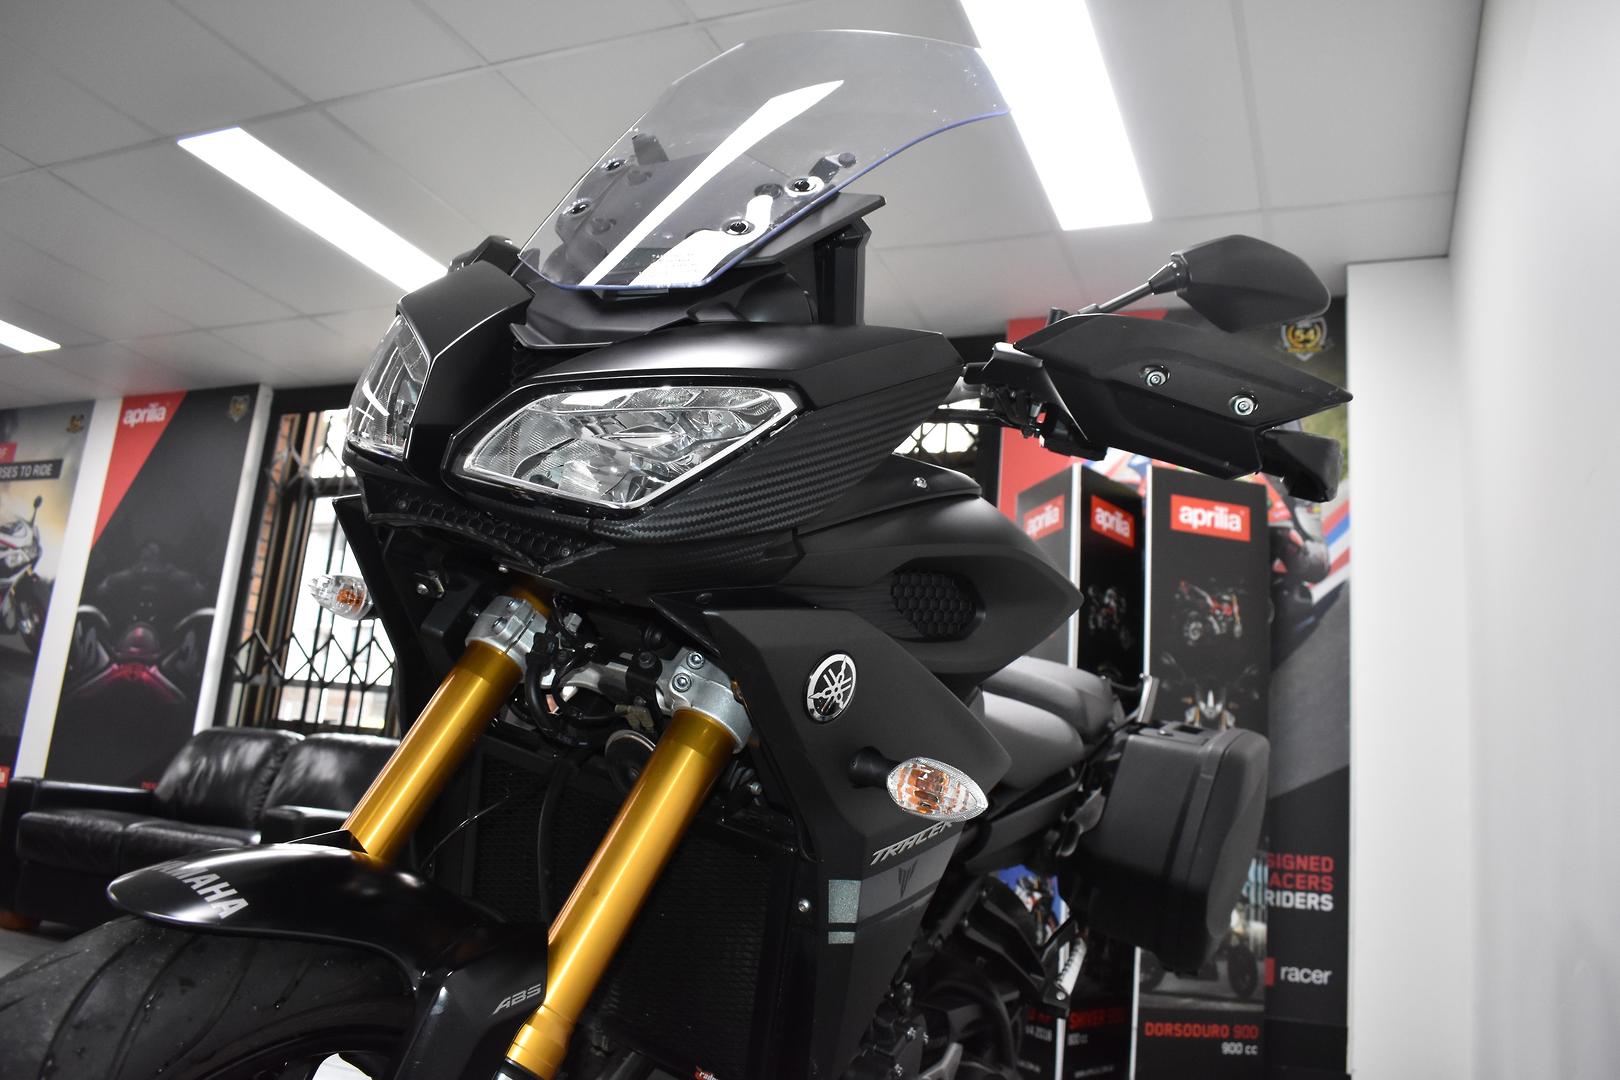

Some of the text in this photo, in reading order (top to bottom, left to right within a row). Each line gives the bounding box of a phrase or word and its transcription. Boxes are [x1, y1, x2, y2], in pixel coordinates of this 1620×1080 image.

[123, 401, 167, 428] aprilia
[20, 464, 32, 478] TO
[32, 463, 53, 477] RIDE
[1024, 503, 1060, 537] aprilia
[1095, 506, 1131, 538] aprilia
[1179, 504, 1242, 532] aprilia
[870, 821, 952, 866] TRACER
[1267, 852, 1334, 873] SIGNED
[151, 860, 249, 919] AMAHA
[1265, 889, 1334, 912] RIDERS
[1280, 965, 1332, 985] racer
[493, 984, 542, 1015] ABS
[1144, 1022, 1259, 1040] DORSODURO 900
[1221, 1042, 1258, 1056] 900 cc
